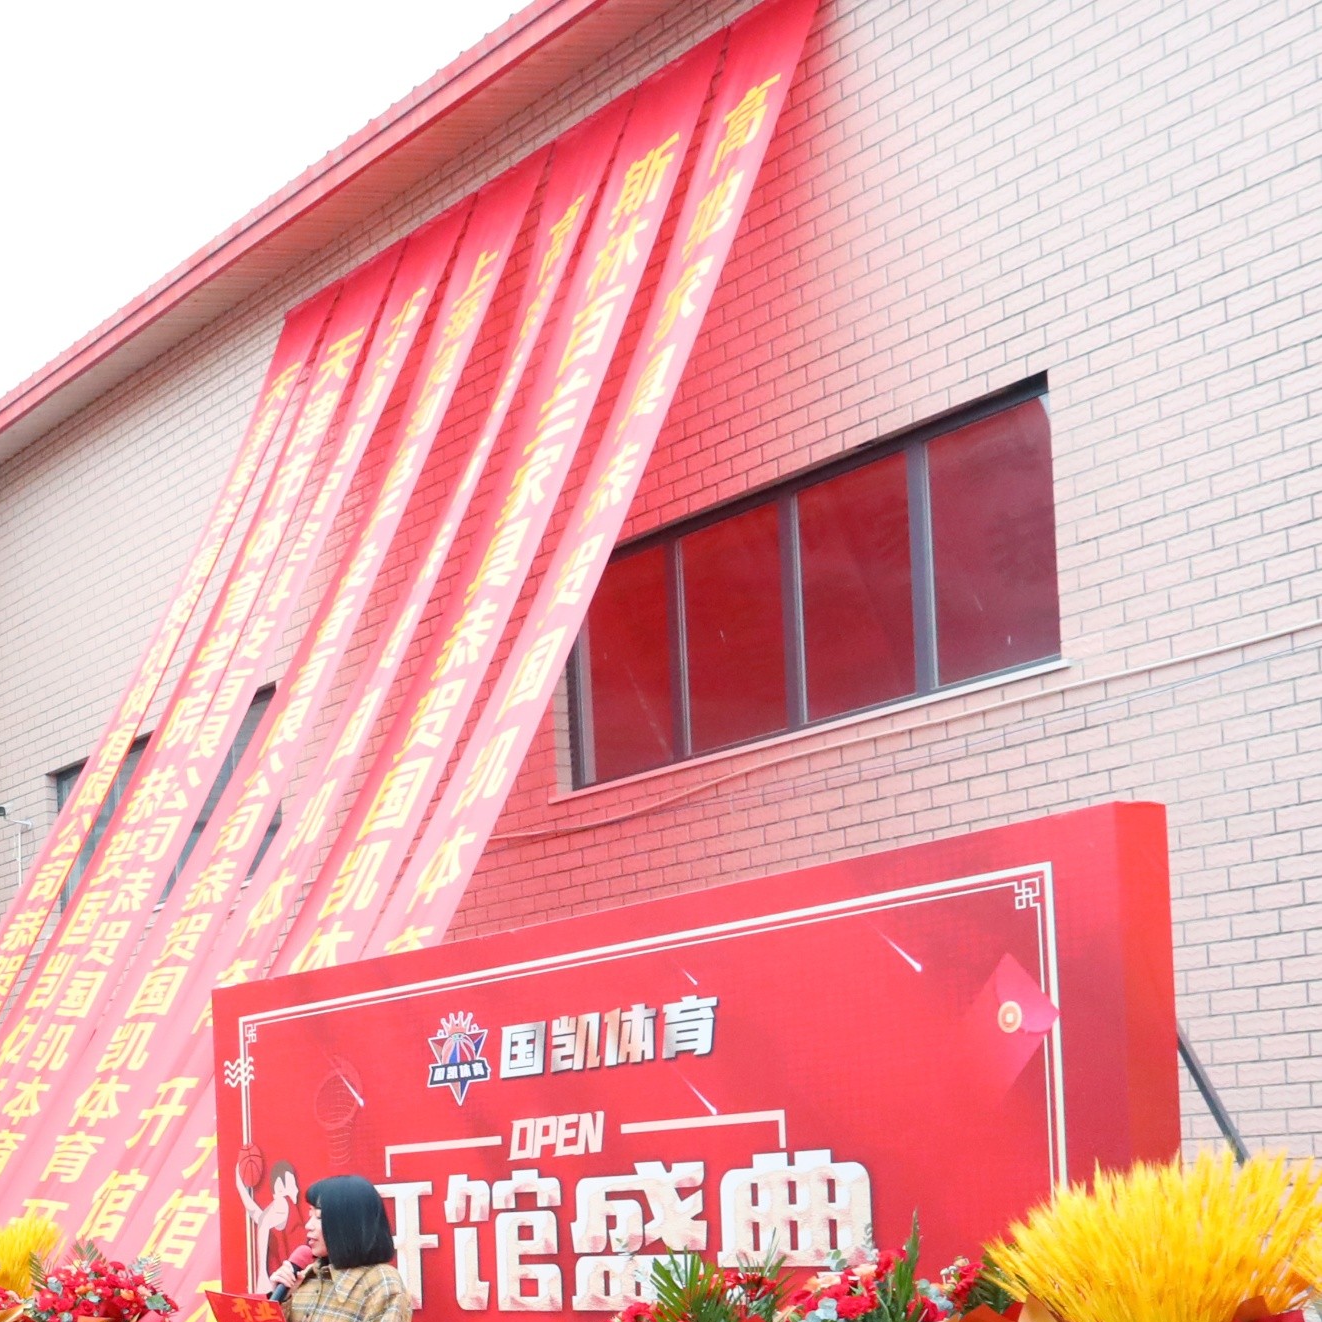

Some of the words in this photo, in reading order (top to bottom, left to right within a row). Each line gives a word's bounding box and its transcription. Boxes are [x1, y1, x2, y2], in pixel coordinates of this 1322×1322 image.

[499, 994, 720, 1081] 国凯体育
[508, 1110, 605, 1162] OPEN
